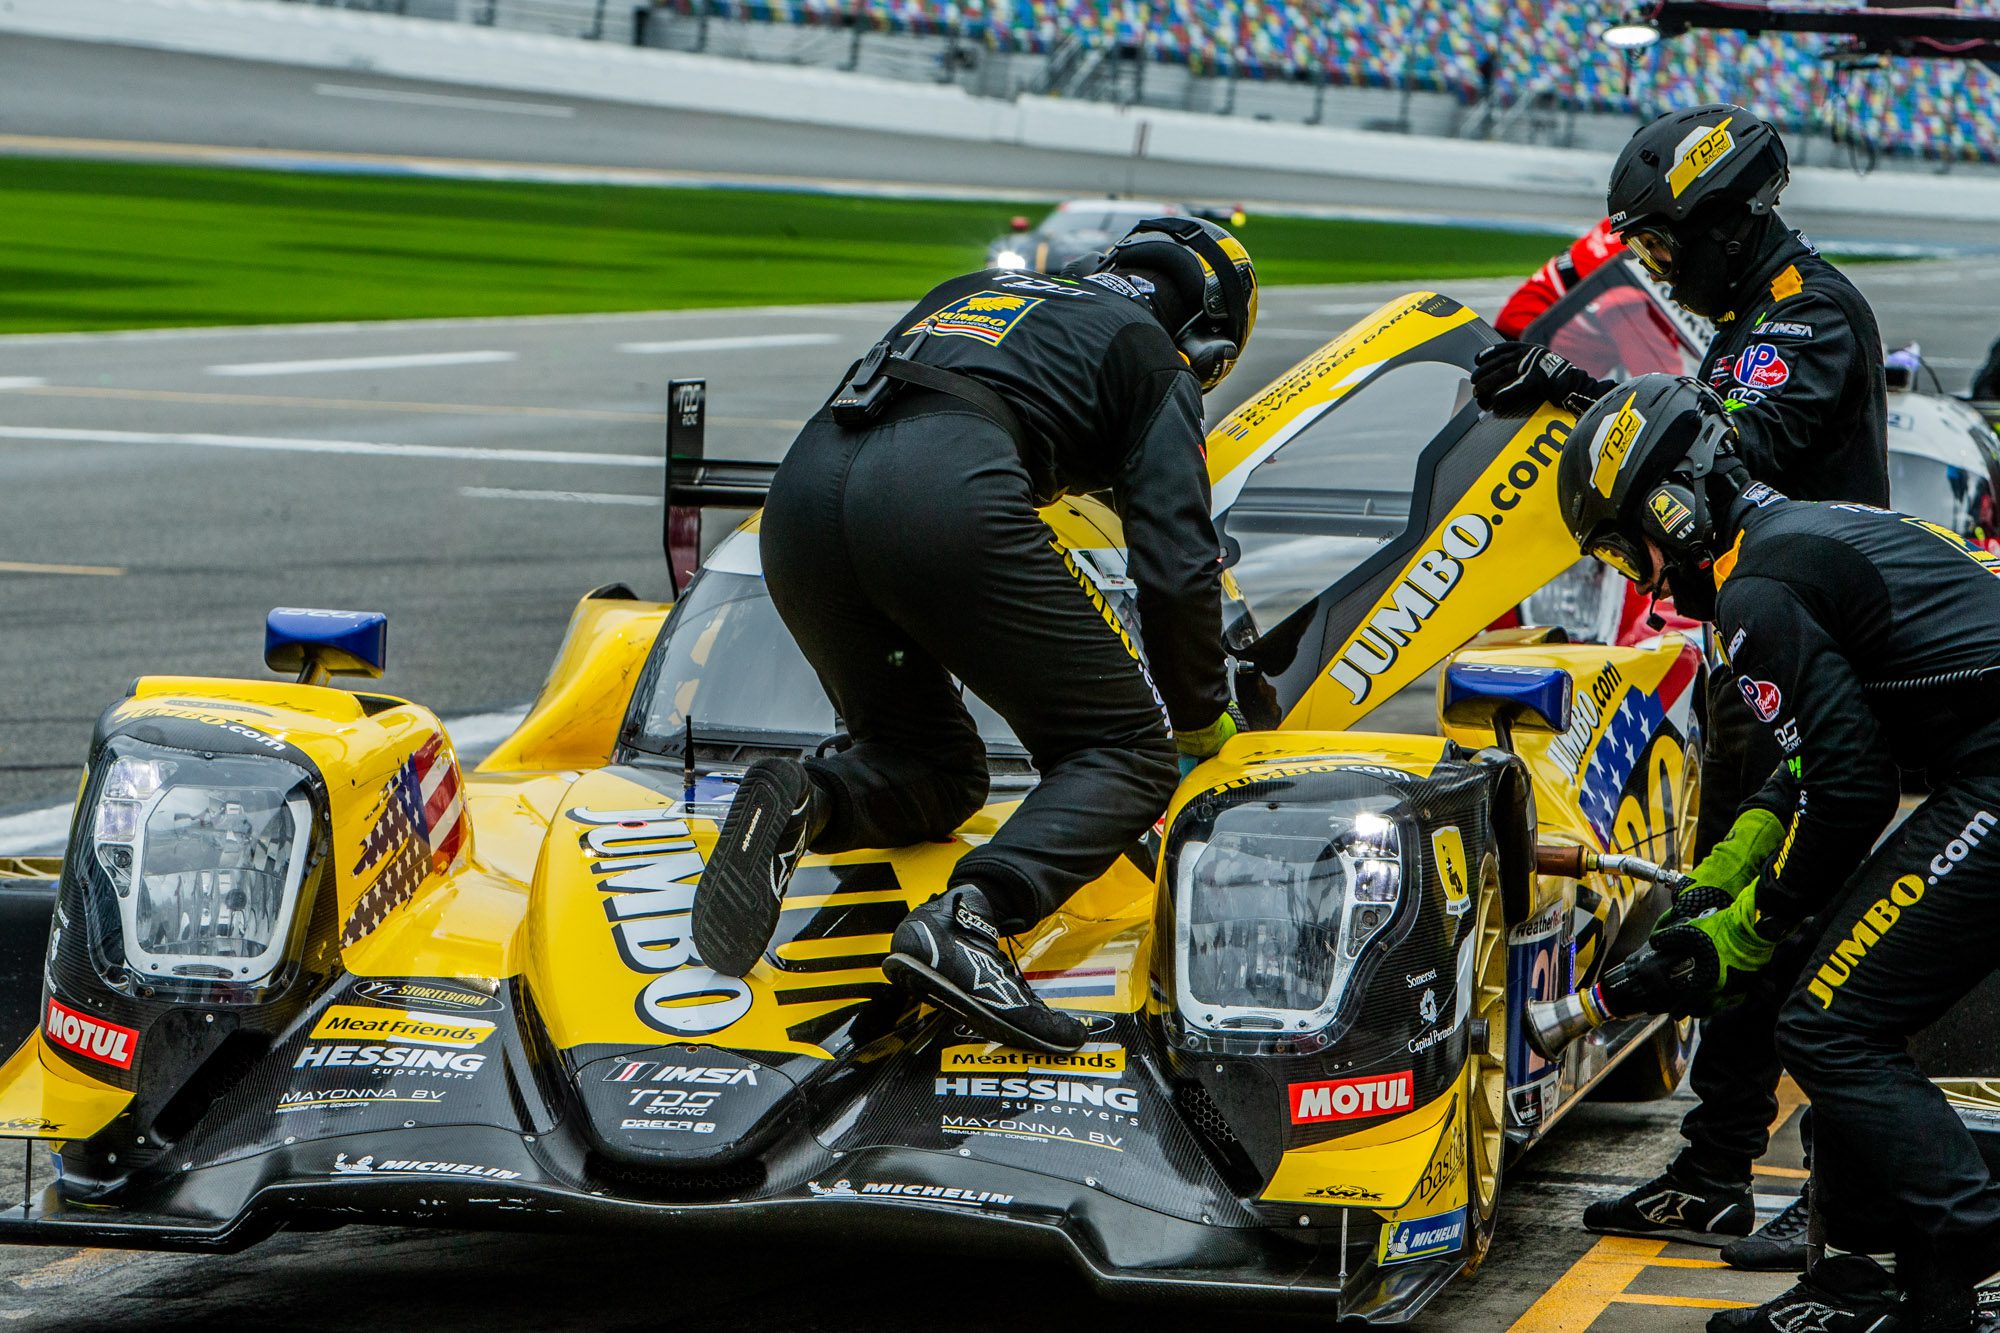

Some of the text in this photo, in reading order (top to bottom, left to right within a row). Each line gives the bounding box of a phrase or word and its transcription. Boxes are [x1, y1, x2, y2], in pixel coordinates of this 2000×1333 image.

[1685, 129, 1725, 167] TDS
[1703, 142, 1729, 165] RACING
[1772, 322, 1813, 337] IMSA
[1318, 347, 1356, 379] DER
[1738, 343, 1777, 385] VP
[1754, 367, 1788, 382] Racing
[1601, 410, 1633, 461] TDS
[1618, 420, 1640, 453] RACING
[1329, 419, 1575, 705] JUMBO.com
[1213, 764, 1411, 796] JUMBO.com
[566, 806, 754, 1038] JUMBO
[1807, 810, 1998, 1010] JUMBO.com
[1406, 968, 1437, 988] Somerset
[398, 984, 489, 1006] STORTEBOOM
[48, 1006, 128, 1062] MOTUL
[325, 1017, 480, 1041] MeatFriends
[1408, 1026, 1454, 1054] Capital Partners
[293, 1046, 487, 1072] HESSING
[952, 1053, 1117, 1069] MeatFriends
[371, 1067, 475, 1081] supervers
[650, 1066, 758, 1086] IMSA
[275, 1101, 370, 1114] PREMIUM FISH CONCEPTS
[280, 1088, 447, 1104] MAYONNA BV
[628, 1088, 722, 1108] TDS
[934, 1077, 1139, 1113] HESSING
[1298, 1078, 1411, 1118] MOTUL
[643, 1106, 708, 1117] RACING
[1002, 1100, 1140, 1127] supervers
[621, 1119, 693, 1131] ORECA
[942, 1114, 1122, 1146] MAYONNA BV
[942, 1128, 980, 1136] PREMIUM
[1004, 1134, 1049, 1143] CONCEPTS
[378, 1160, 522, 1180] MICHELIN
[862, 1183, 1015, 1205] MICHELIN
[1410, 1222, 1461, 1249] MICHELIN
